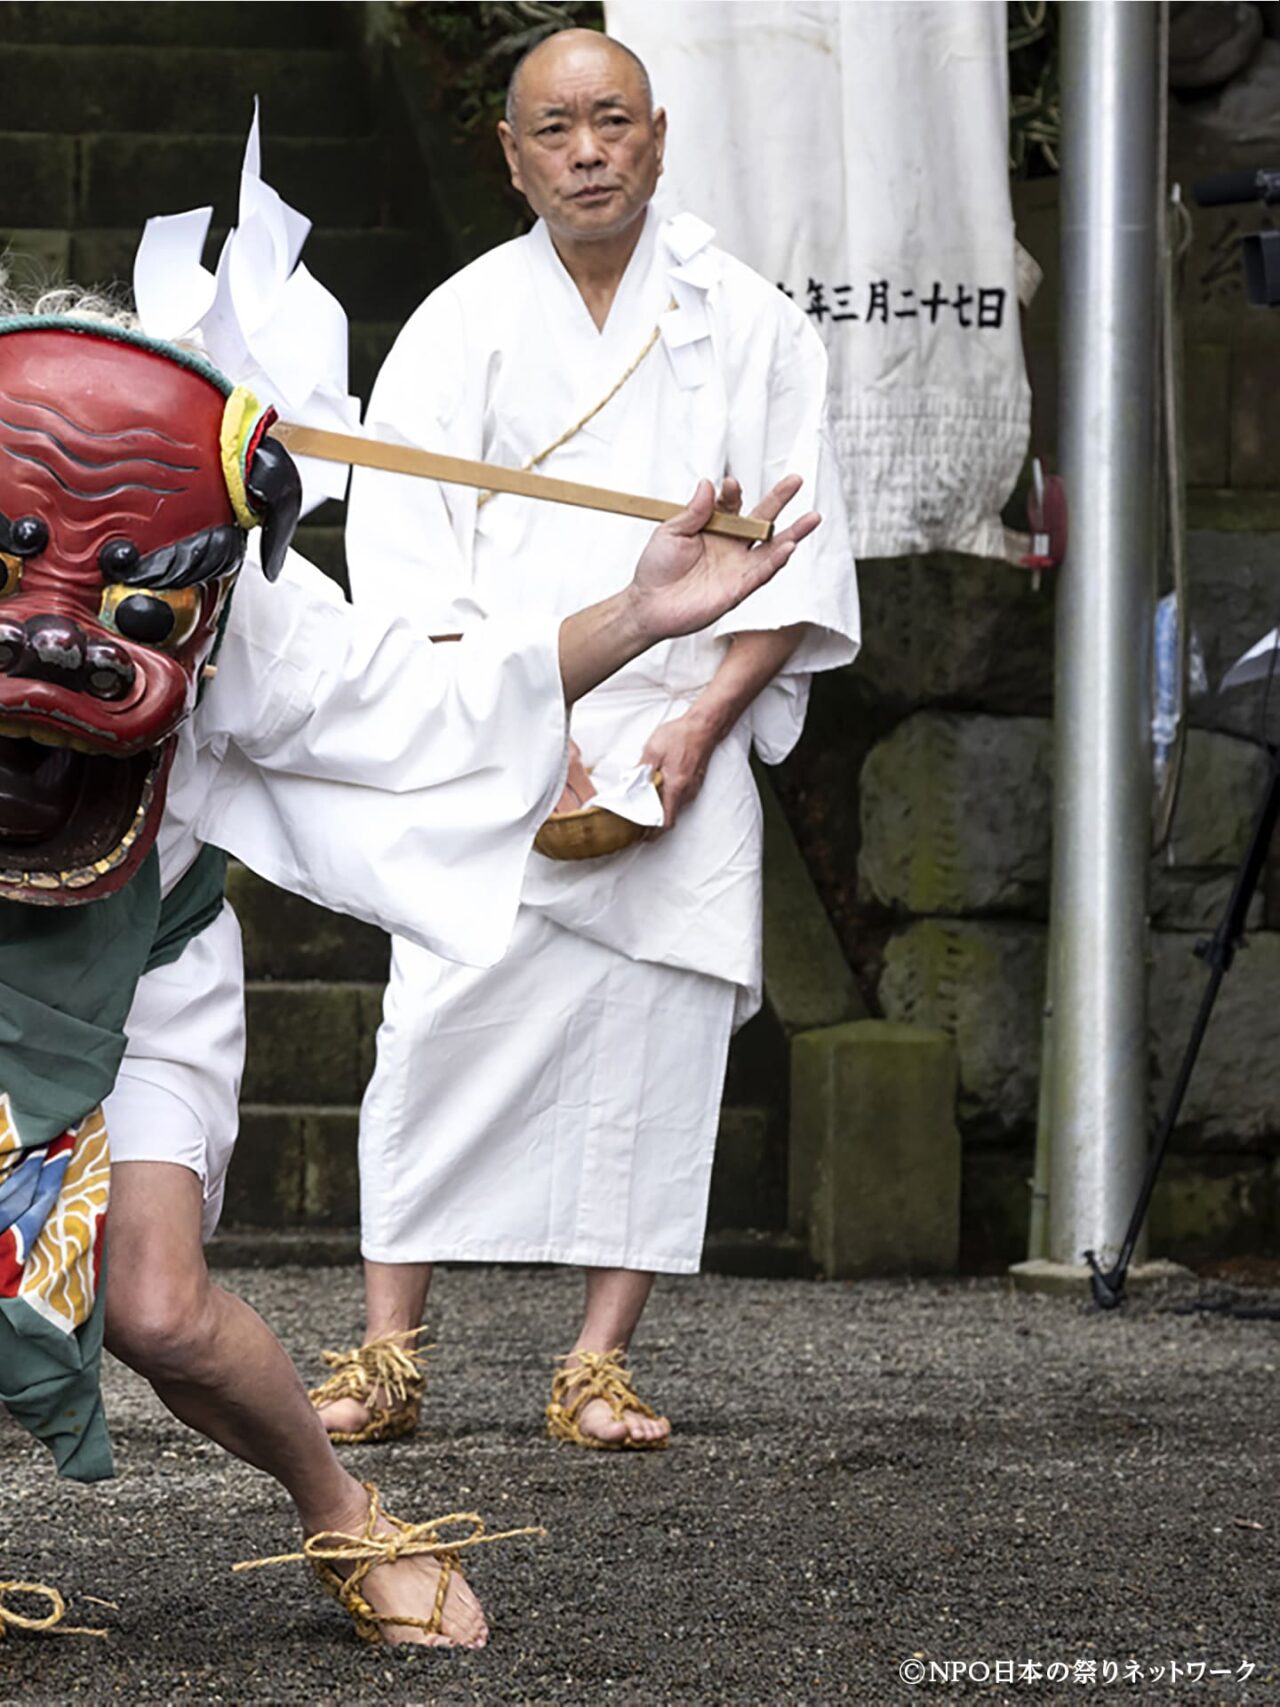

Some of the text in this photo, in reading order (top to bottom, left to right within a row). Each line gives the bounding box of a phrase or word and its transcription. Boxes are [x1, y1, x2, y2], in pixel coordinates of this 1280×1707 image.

[776, 277, 1006, 329] 年三月二十七日
